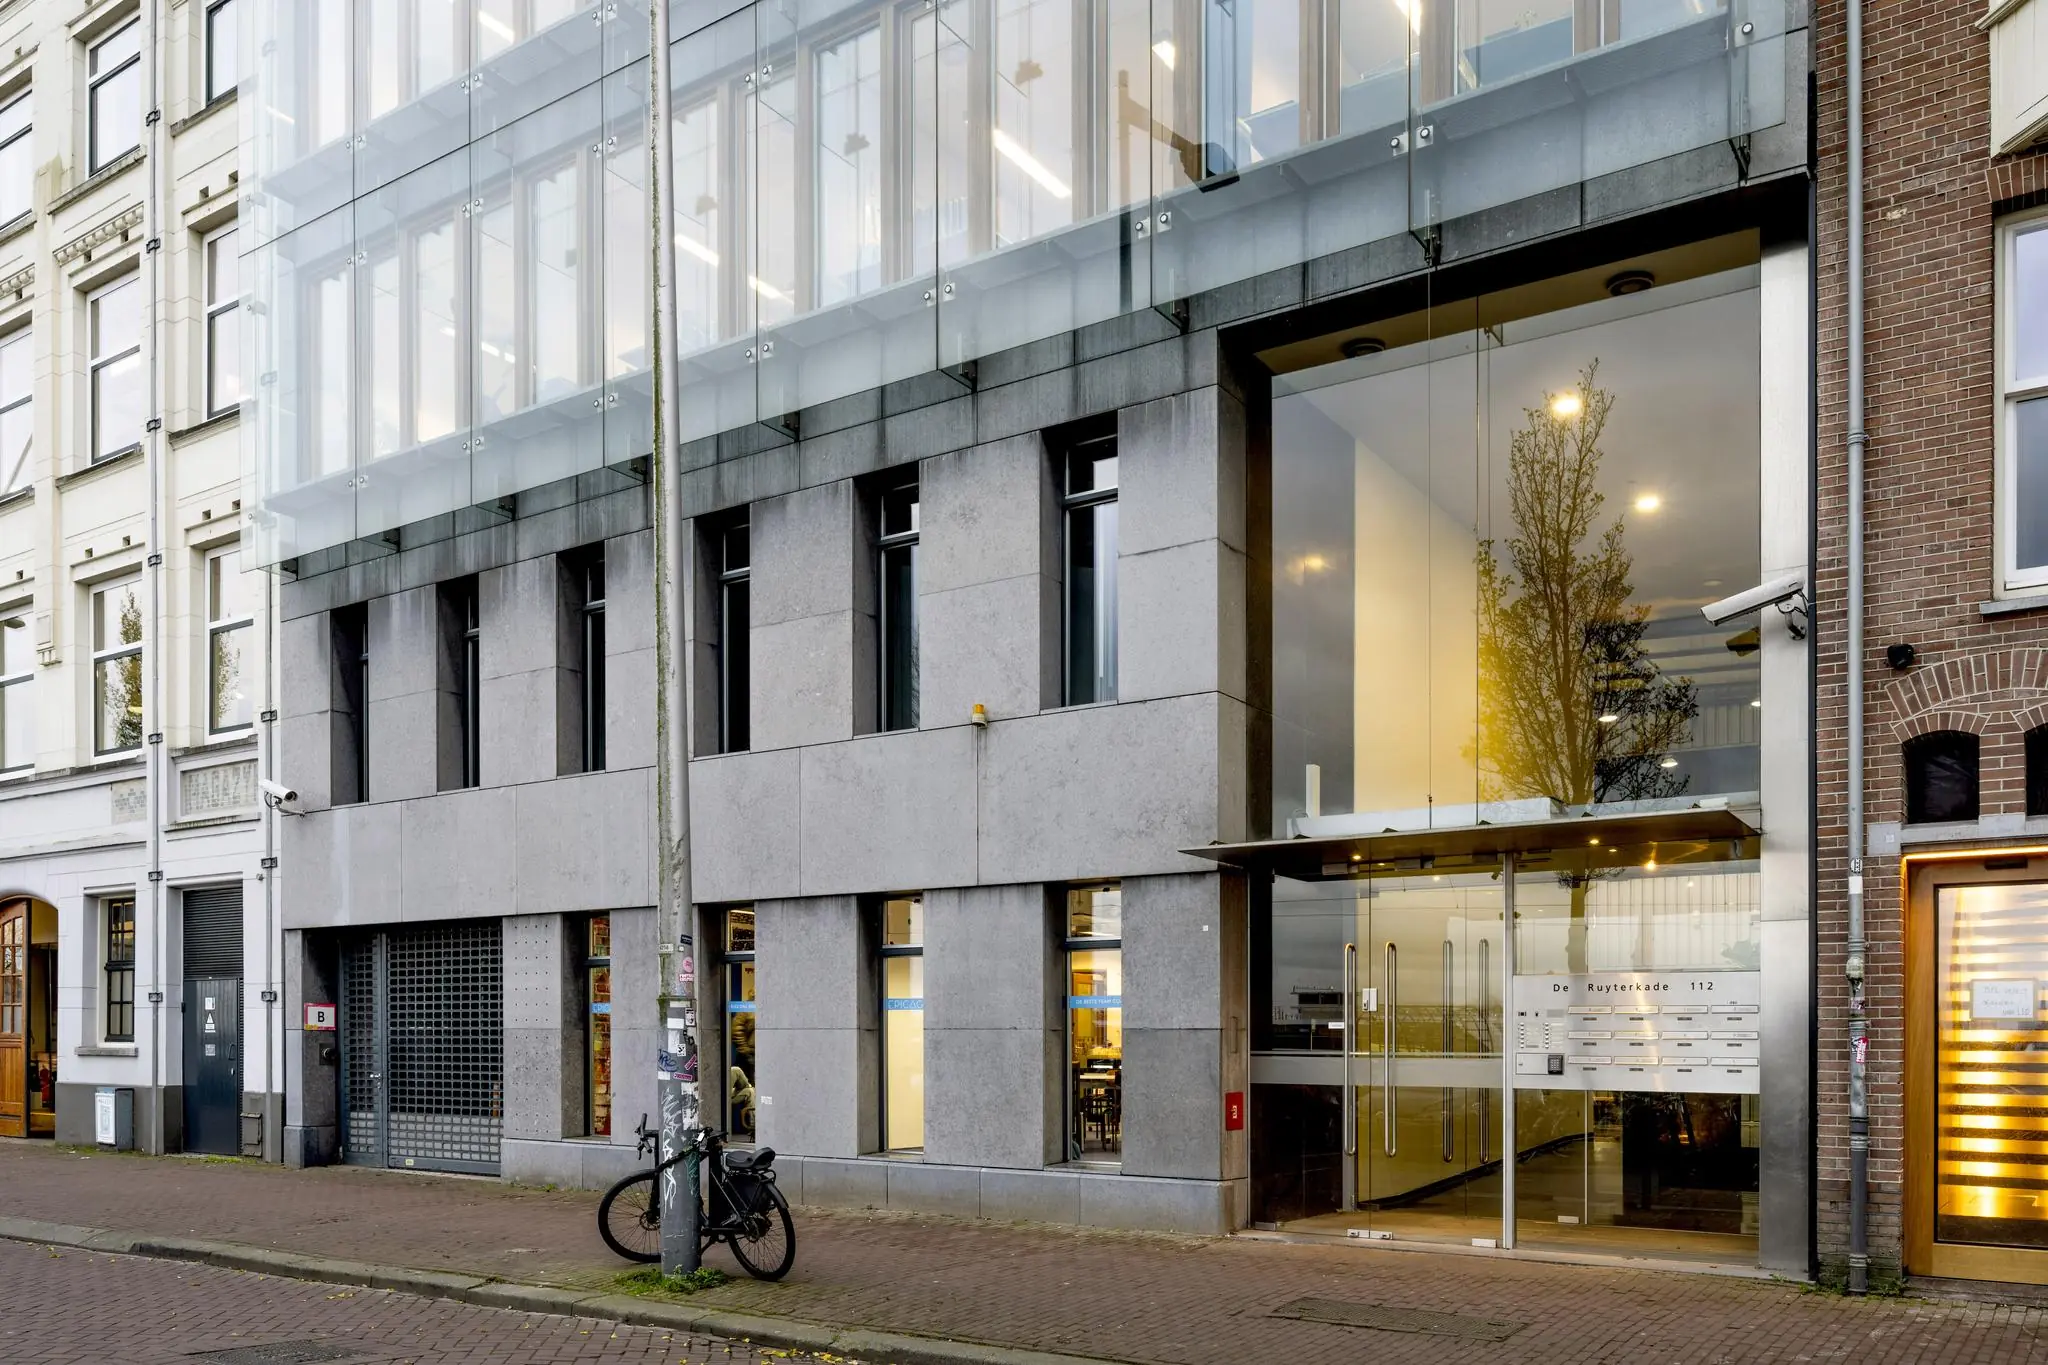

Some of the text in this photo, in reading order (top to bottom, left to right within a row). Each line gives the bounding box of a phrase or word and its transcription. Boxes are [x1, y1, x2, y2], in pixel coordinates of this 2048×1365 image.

[1553, 981, 1714, 993] De Ruyterkade 112
[317, 1011, 325, 1023] B
